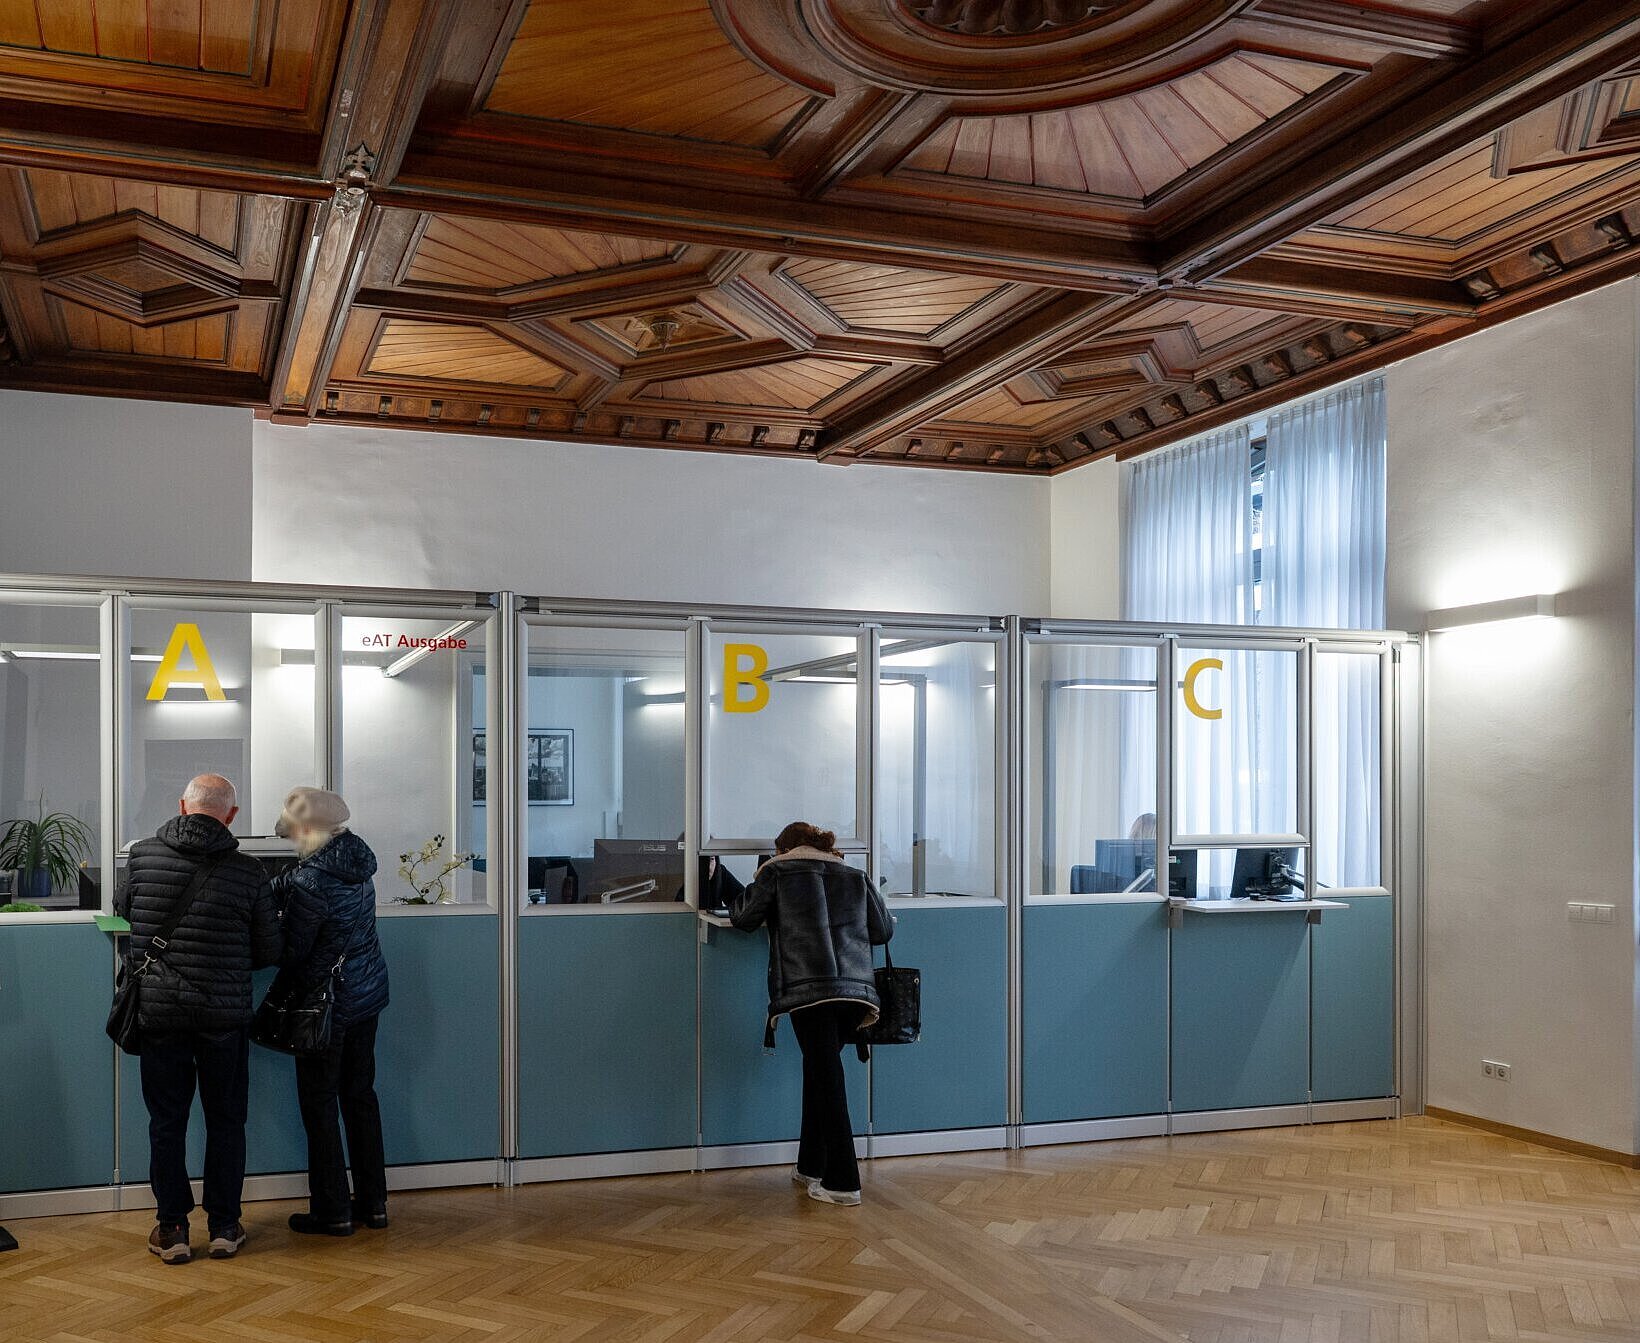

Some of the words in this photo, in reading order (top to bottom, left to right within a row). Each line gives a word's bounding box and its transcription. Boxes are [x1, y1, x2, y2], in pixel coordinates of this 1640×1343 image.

[145, 623, 227, 701] A
[362, 634, 392, 647] eAT
[397, 634, 467, 652] Ausgabe
[723, 643, 771, 713] B
[1183, 658, 1223, 720] C
